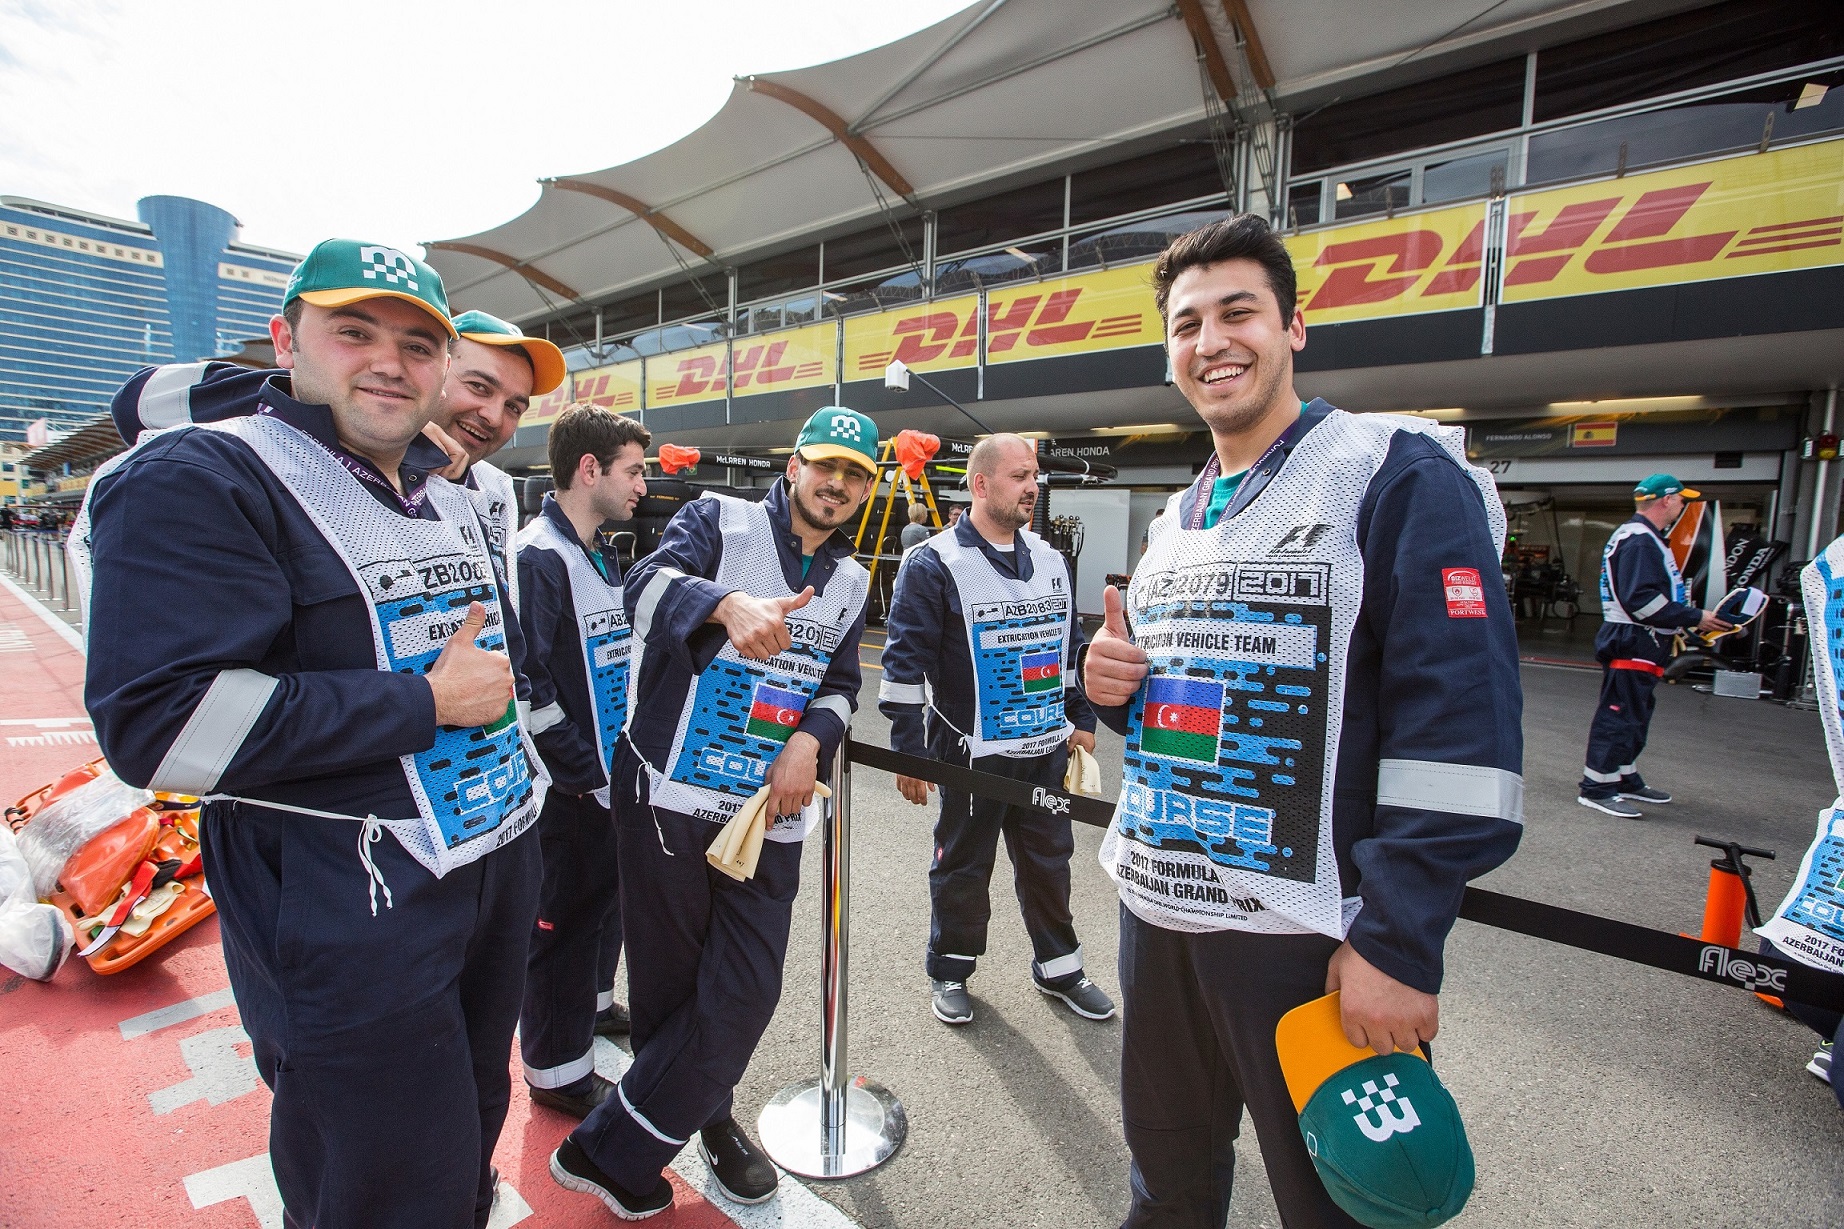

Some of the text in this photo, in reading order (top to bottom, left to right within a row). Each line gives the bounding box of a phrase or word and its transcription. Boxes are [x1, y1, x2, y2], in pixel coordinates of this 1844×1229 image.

[1304, 181, 1738, 311] DHL
[890, 287, 1096, 364] DHL
[675, 340, 797, 397] DHL
[538, 375, 616, 418] DHL
[1076, 446, 1110, 456] HONDA
[1486, 434, 1523, 442] FERNANDO
[716, 455, 771, 468] McLAREN HONDA
[1490, 460, 1512, 474] 27
[1238, 570, 1321, 597] 2017
[1176, 632, 1229, 651] VEHICLE
[1234, 635, 1276, 654] TEAM
[1032, 786, 1071, 815] flex
[1121, 784, 1274, 846] OURSE
[1130, 850, 1221, 885] 2017 FORMULA
[1173, 883, 1229, 905] GRAND
[1804, 934, 1829, 950] 2017
[1699, 945, 1788, 992] flex
